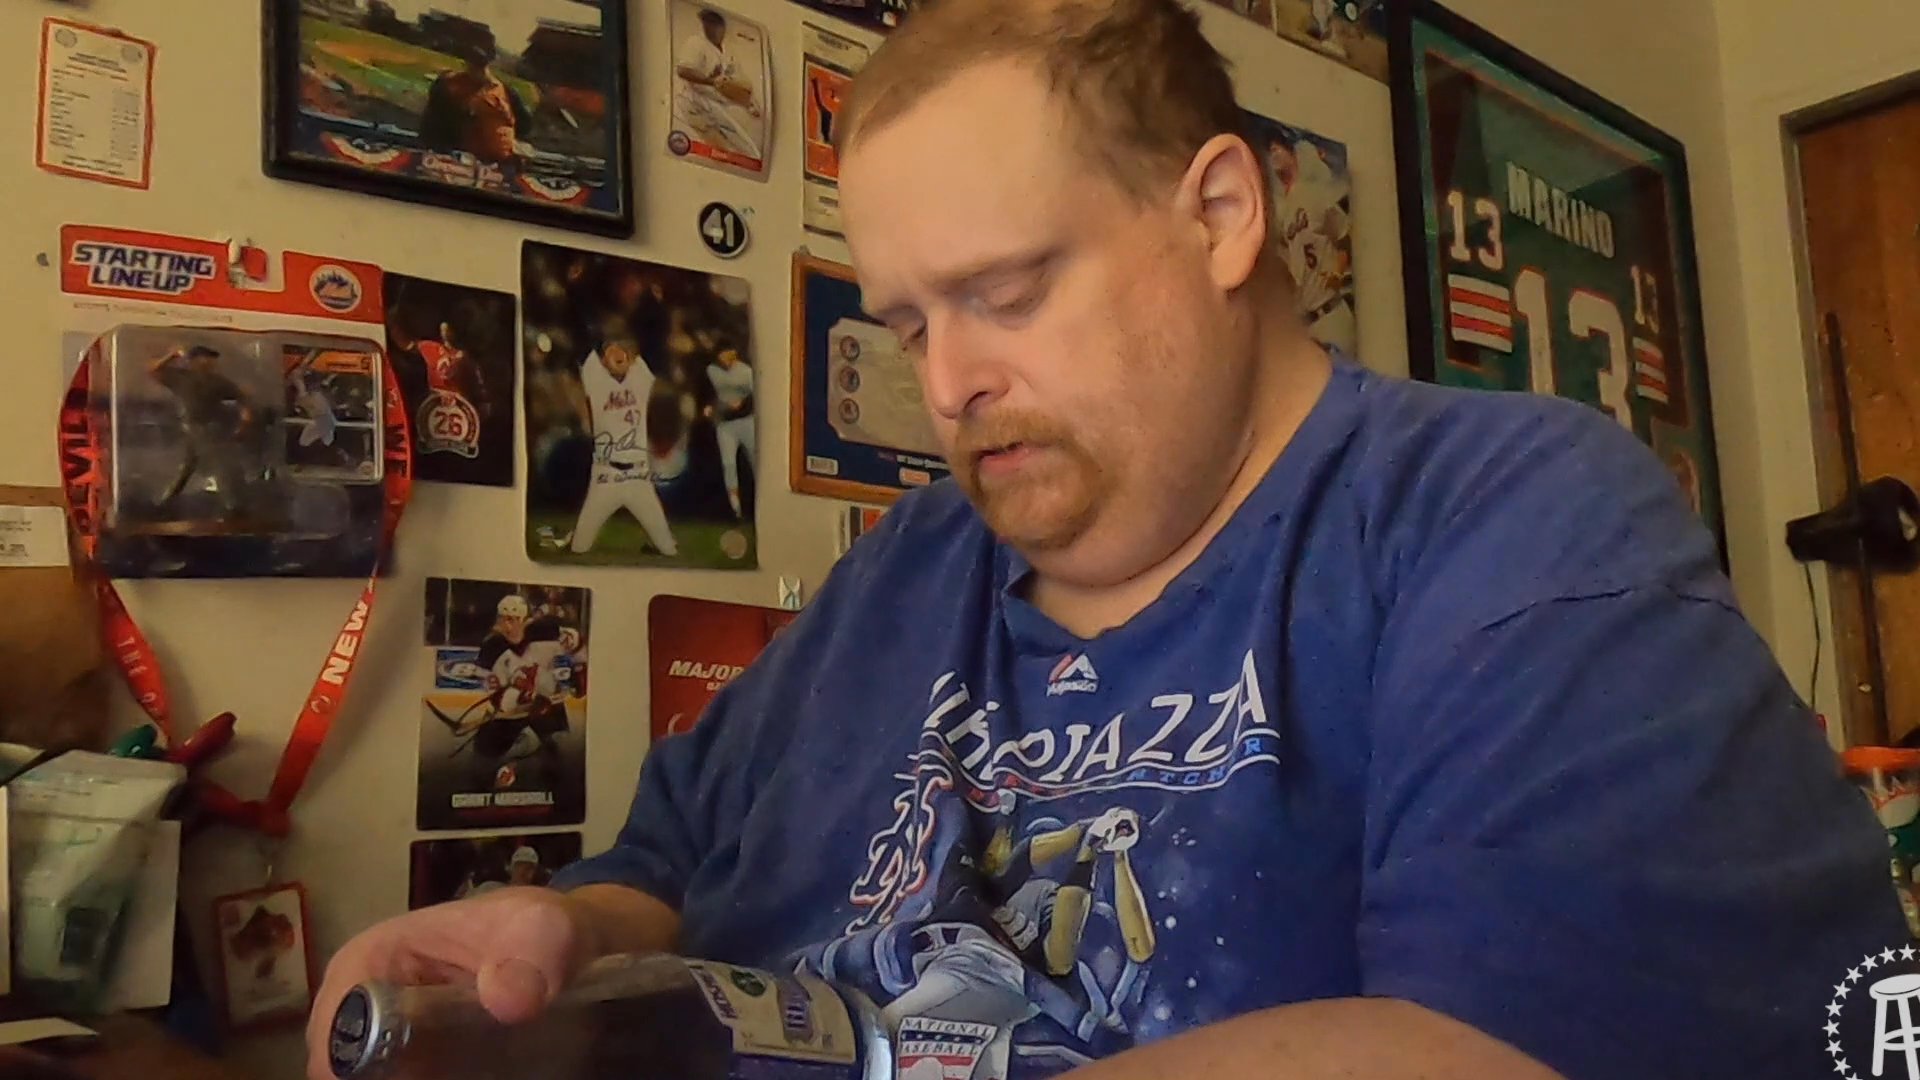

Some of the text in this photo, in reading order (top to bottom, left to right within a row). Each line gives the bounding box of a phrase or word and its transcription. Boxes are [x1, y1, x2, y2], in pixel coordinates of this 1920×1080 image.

[702, 208, 736, 248] 41
[1506, 161, 1616, 259] MARINO
[1448, 190, 1503, 271] 13
[74, 242, 214, 277] STARTING
[90, 265, 192, 291] LINEUP
[1514, 267, 1634, 432] 13
[434, 411, 463, 436] 26
[321, 600, 368, 685] NEW
[903, 1018, 991, 1038] NATIONAL
